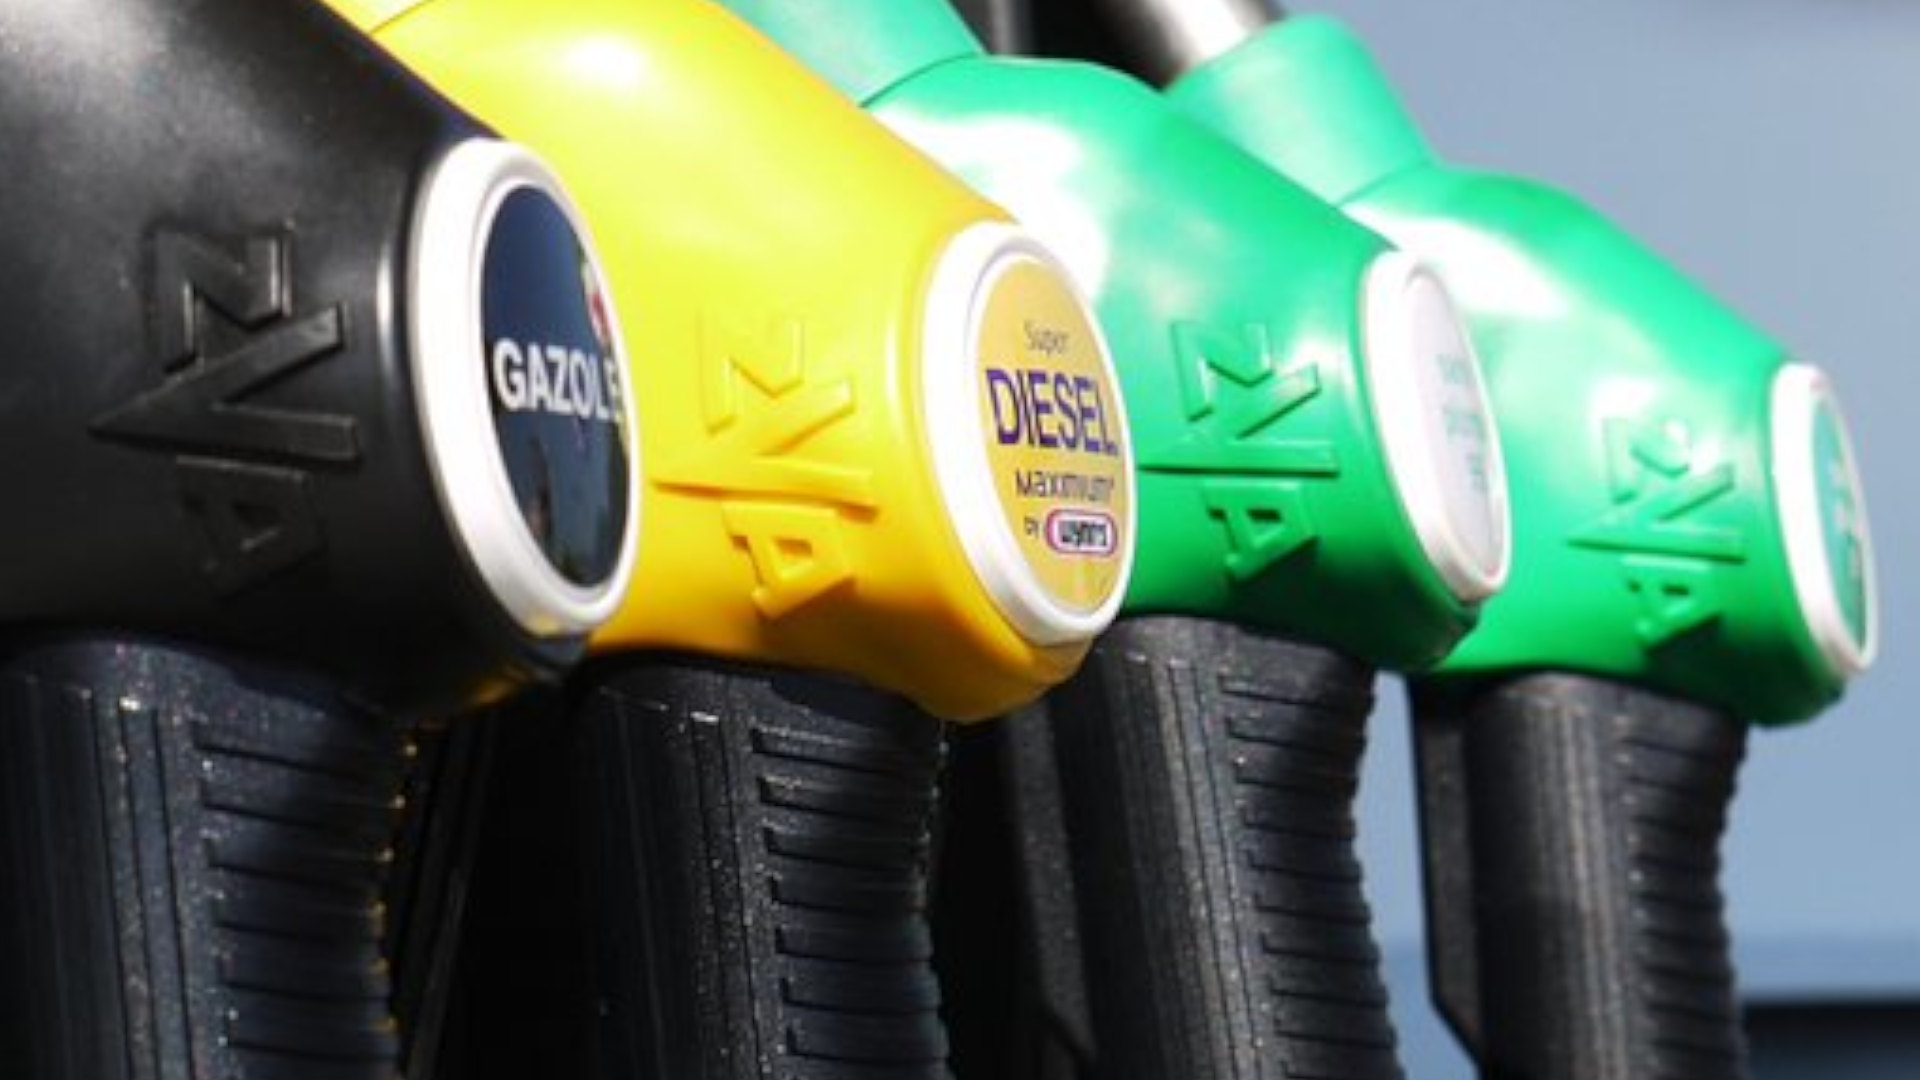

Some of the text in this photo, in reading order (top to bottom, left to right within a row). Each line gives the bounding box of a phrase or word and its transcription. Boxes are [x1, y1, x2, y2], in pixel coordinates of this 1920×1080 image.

[493, 337, 624, 424] GAZOLE
[1023, 320, 1069, 357] Super
[986, 369, 1119, 456] DIESEL
